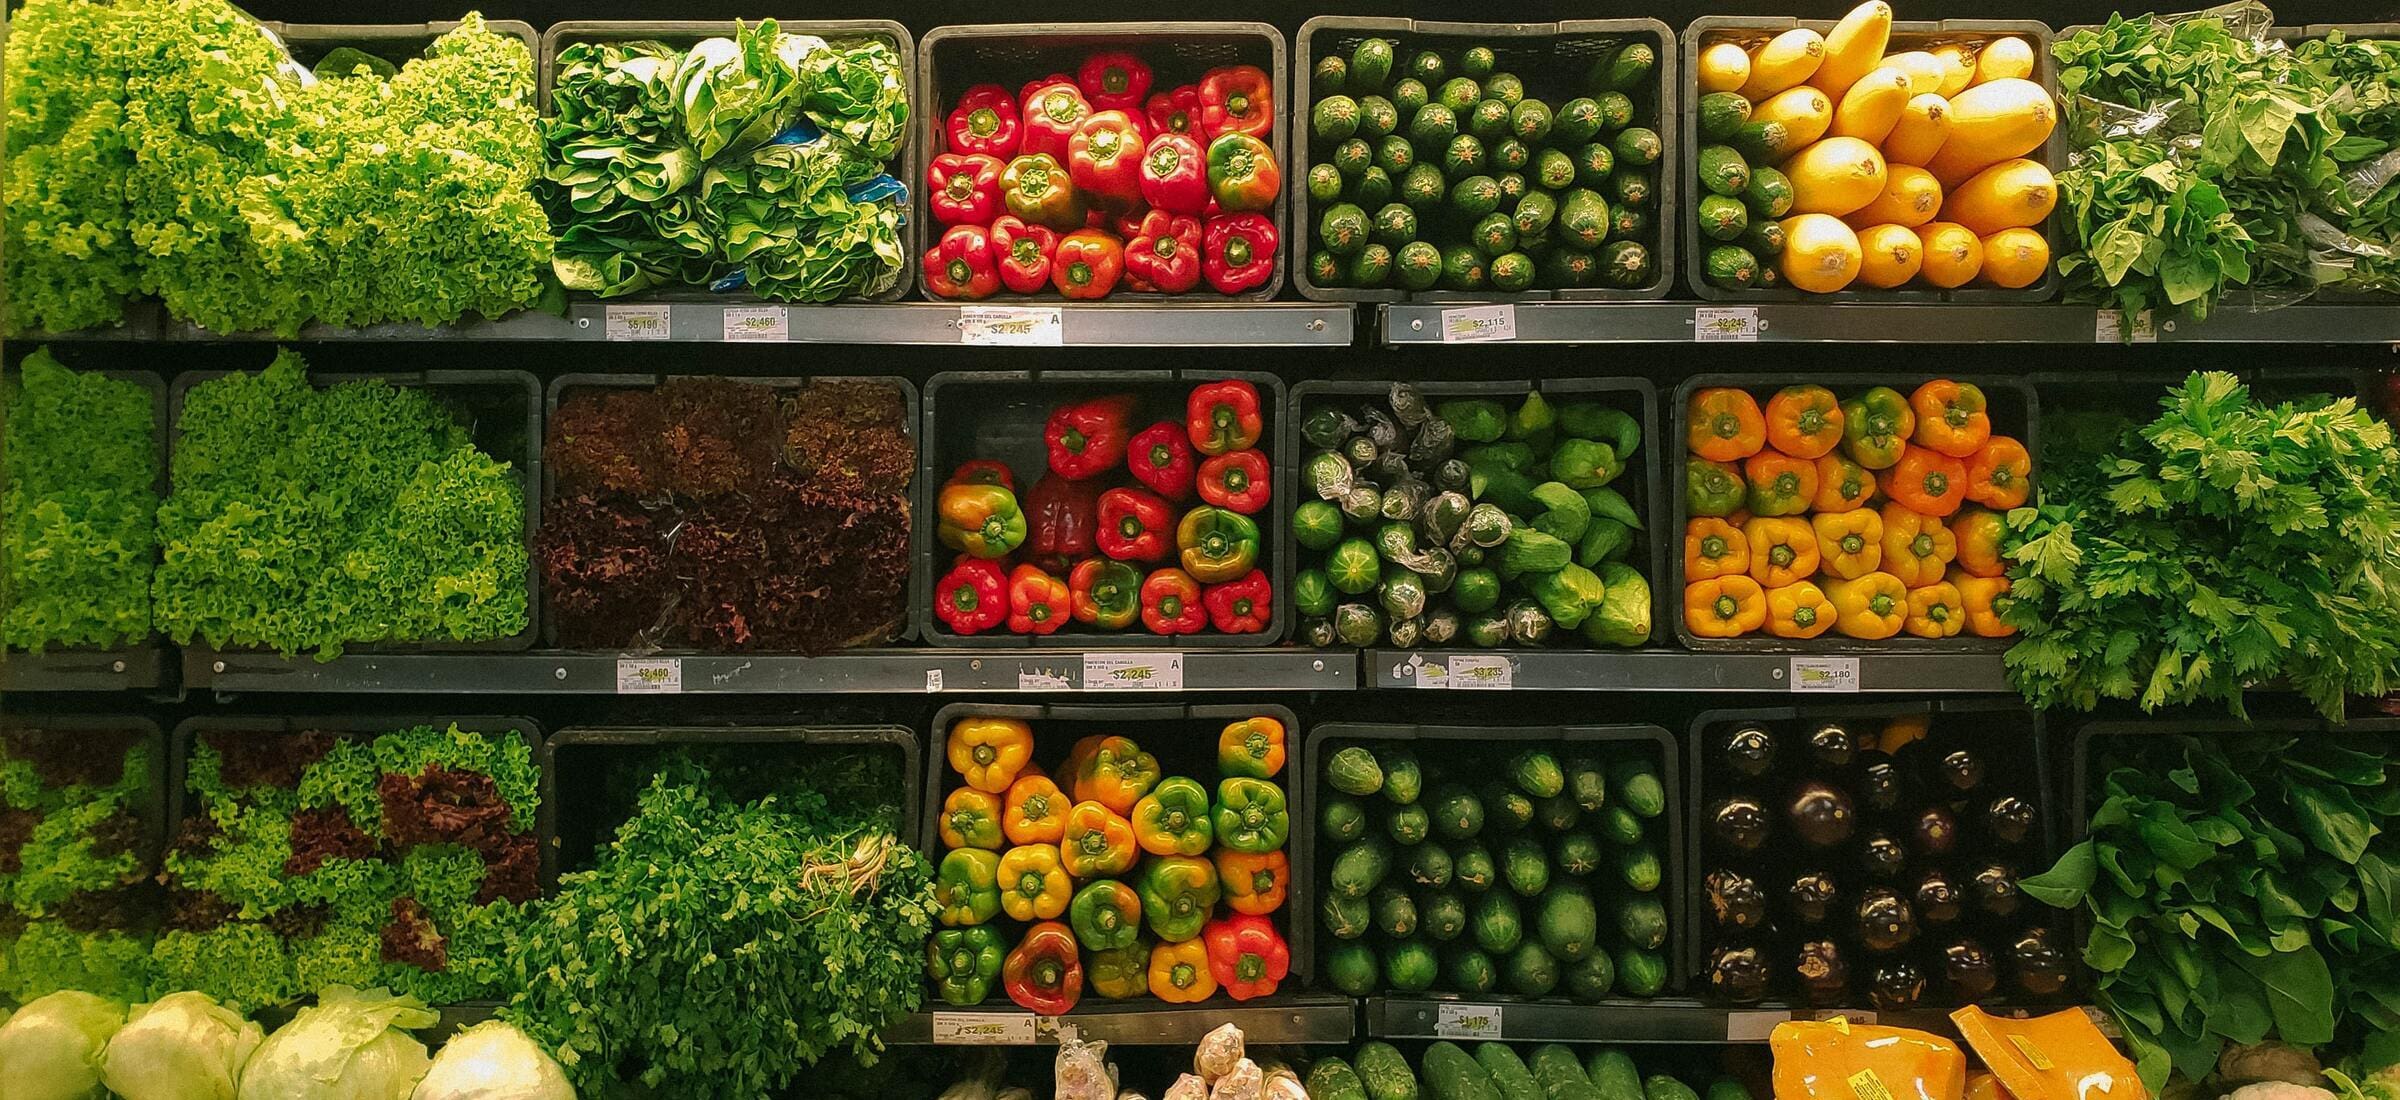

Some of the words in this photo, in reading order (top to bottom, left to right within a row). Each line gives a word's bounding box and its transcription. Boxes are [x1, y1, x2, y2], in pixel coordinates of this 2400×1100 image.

[663, 311, 669, 320] C
[781, 308, 786, 317] C
[745, 317, 776, 328] $2,460
[1051, 314, 1060, 324] A
[1472, 318, 1505, 328] $2,115
[1717, 318, 1747, 328] $2,245
[628, 319, 658, 330] $5,190
[1171, 659, 1179, 669] A
[638, 668, 669, 679] $2,460
[1113, 669, 1152, 681] $2,245
[1473, 667, 1504, 678] $3,235
[1494, 1008, 1500, 1017] A
[1024, 1019, 1032, 1027] A
[1458, 1015, 1489, 1025] $1,175
[964, 1026, 1004, 1036] $2,245
